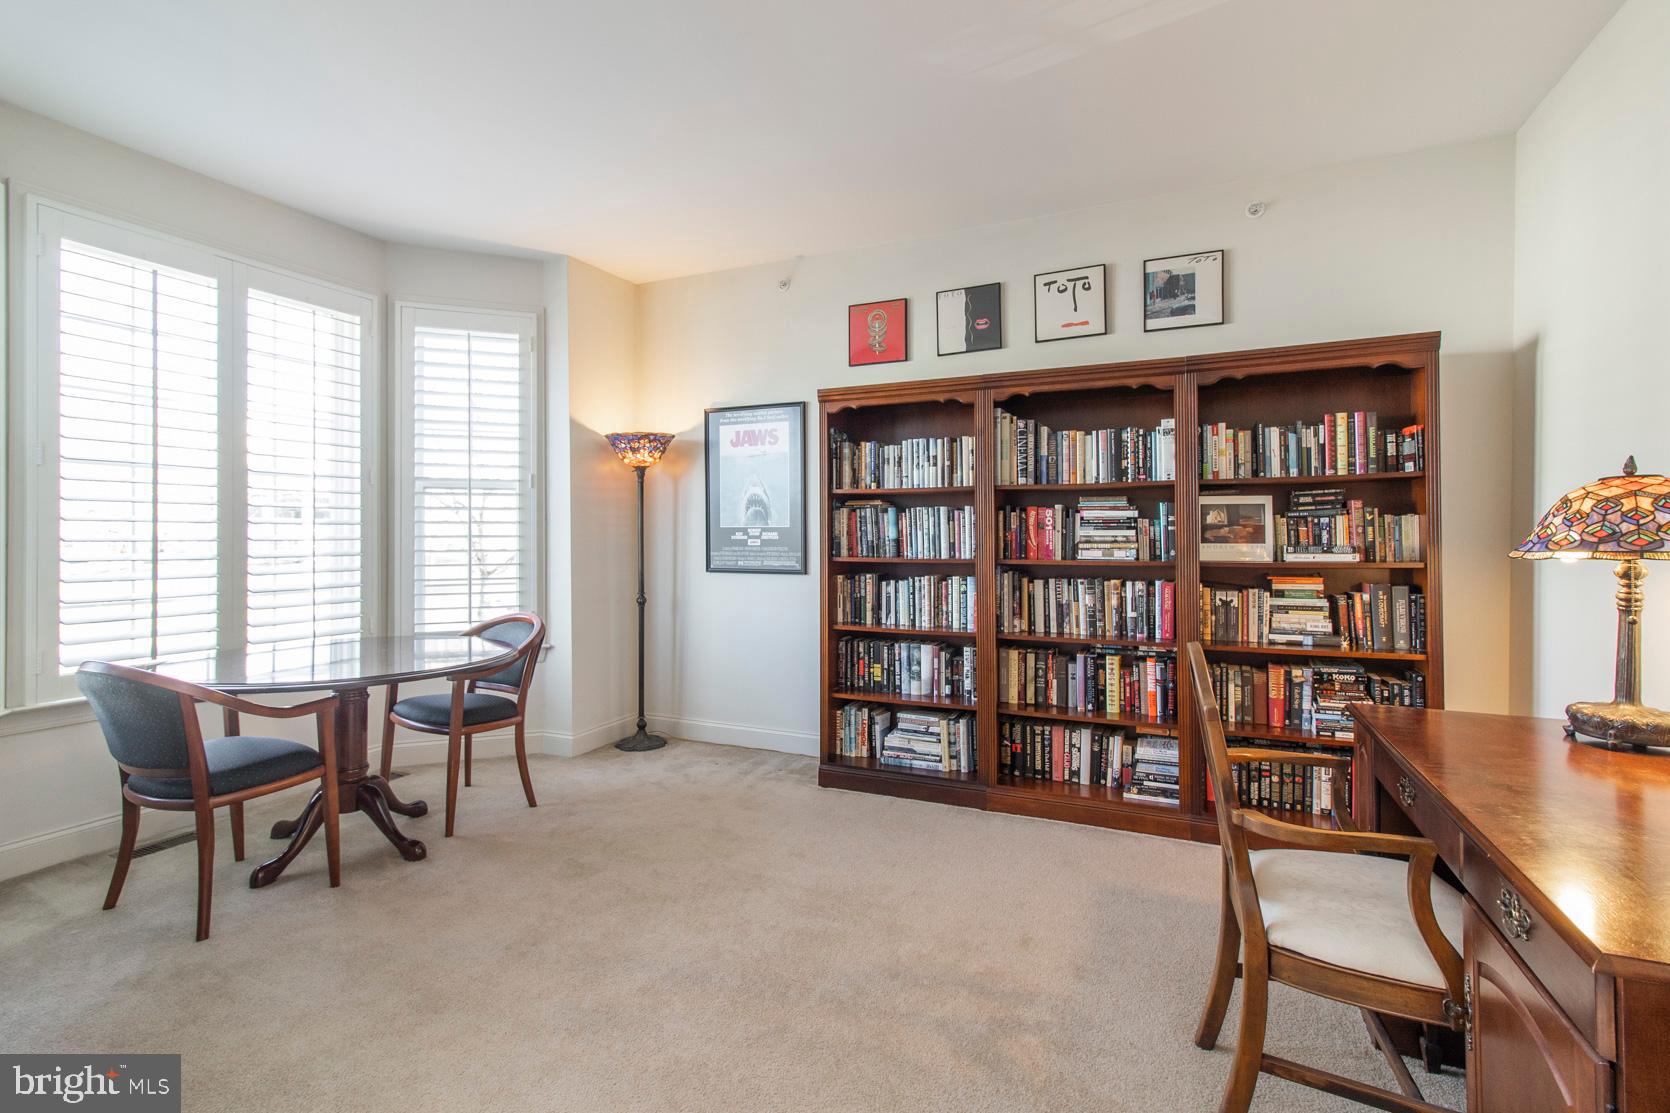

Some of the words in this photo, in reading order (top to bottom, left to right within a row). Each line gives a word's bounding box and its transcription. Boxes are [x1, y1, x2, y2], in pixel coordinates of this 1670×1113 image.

[729, 428, 780, 448] JAWS
[1017, 428, 1027, 470] CINEMA
[1045, 509, 1053, 530] 501
[1147, 661, 1157, 692] AIRFRAME
[1332, 673, 1356, 681] KOKO
